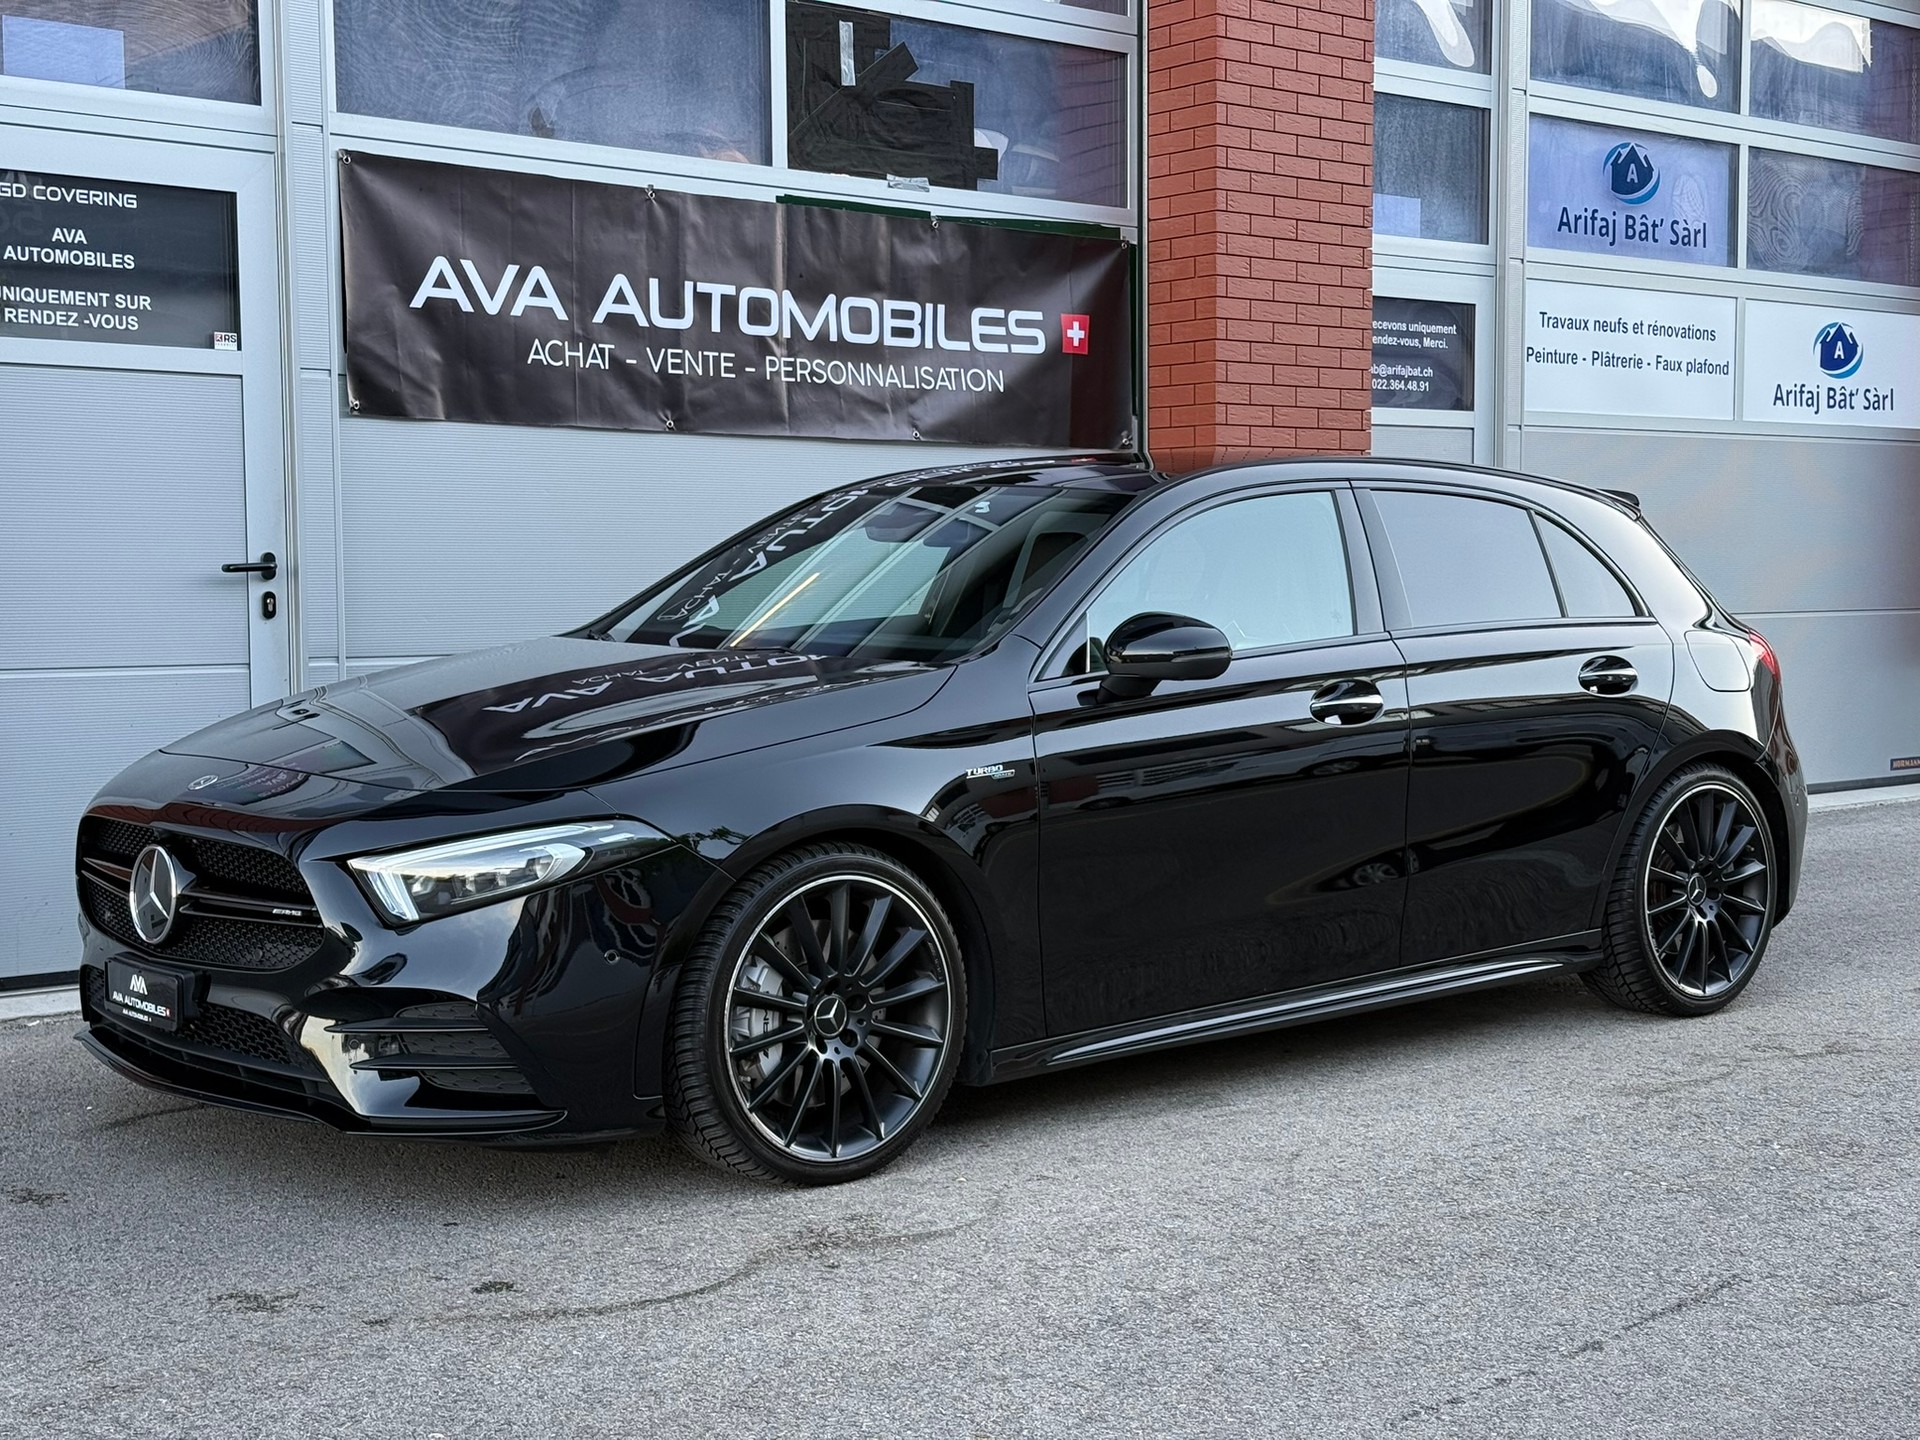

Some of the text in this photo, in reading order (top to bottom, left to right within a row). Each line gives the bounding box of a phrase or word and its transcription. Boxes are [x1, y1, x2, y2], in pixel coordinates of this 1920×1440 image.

[33, 185, 137, 209] COVERING
[52, 228, 87, 244] AVA
[1557, 207, 1616, 246] Arifaj
[1670, 219, 1706, 248] Sàrl
[3, 245, 135, 269] AUTOMOBILES
[0, 286, 152, 310] NIQUEMENT SUR
[409, 255, 1046, 354] AVA AUTOMOBILES
[4, 307, 79, 327] RENDEZ
[1372, 320, 1457, 335] ecevons uniquement
[1539, 311, 1717, 342] Travaux neufs et rénovations
[1372, 334, 1448, 349] endez-vous, Merci.
[527, 338, 615, 370] ACHAT
[646, 347, 736, 379] VENTE
[766, 356, 1004, 392] PERSONNALISATION
[1526, 346, 1578, 365] Peinture
[1591, 351, 1643, 369] Plâtrerie
[1655, 355, 1683, 372] Faux
[1686, 358, 1730, 376] plafond
[1371, 379, 1430, 392] 022.364.48.91
[1773, 383, 1820, 415] Arifaj
[1863, 388, 1894, 411] Sàrl
[966, 764, 1004, 776] TURBO
